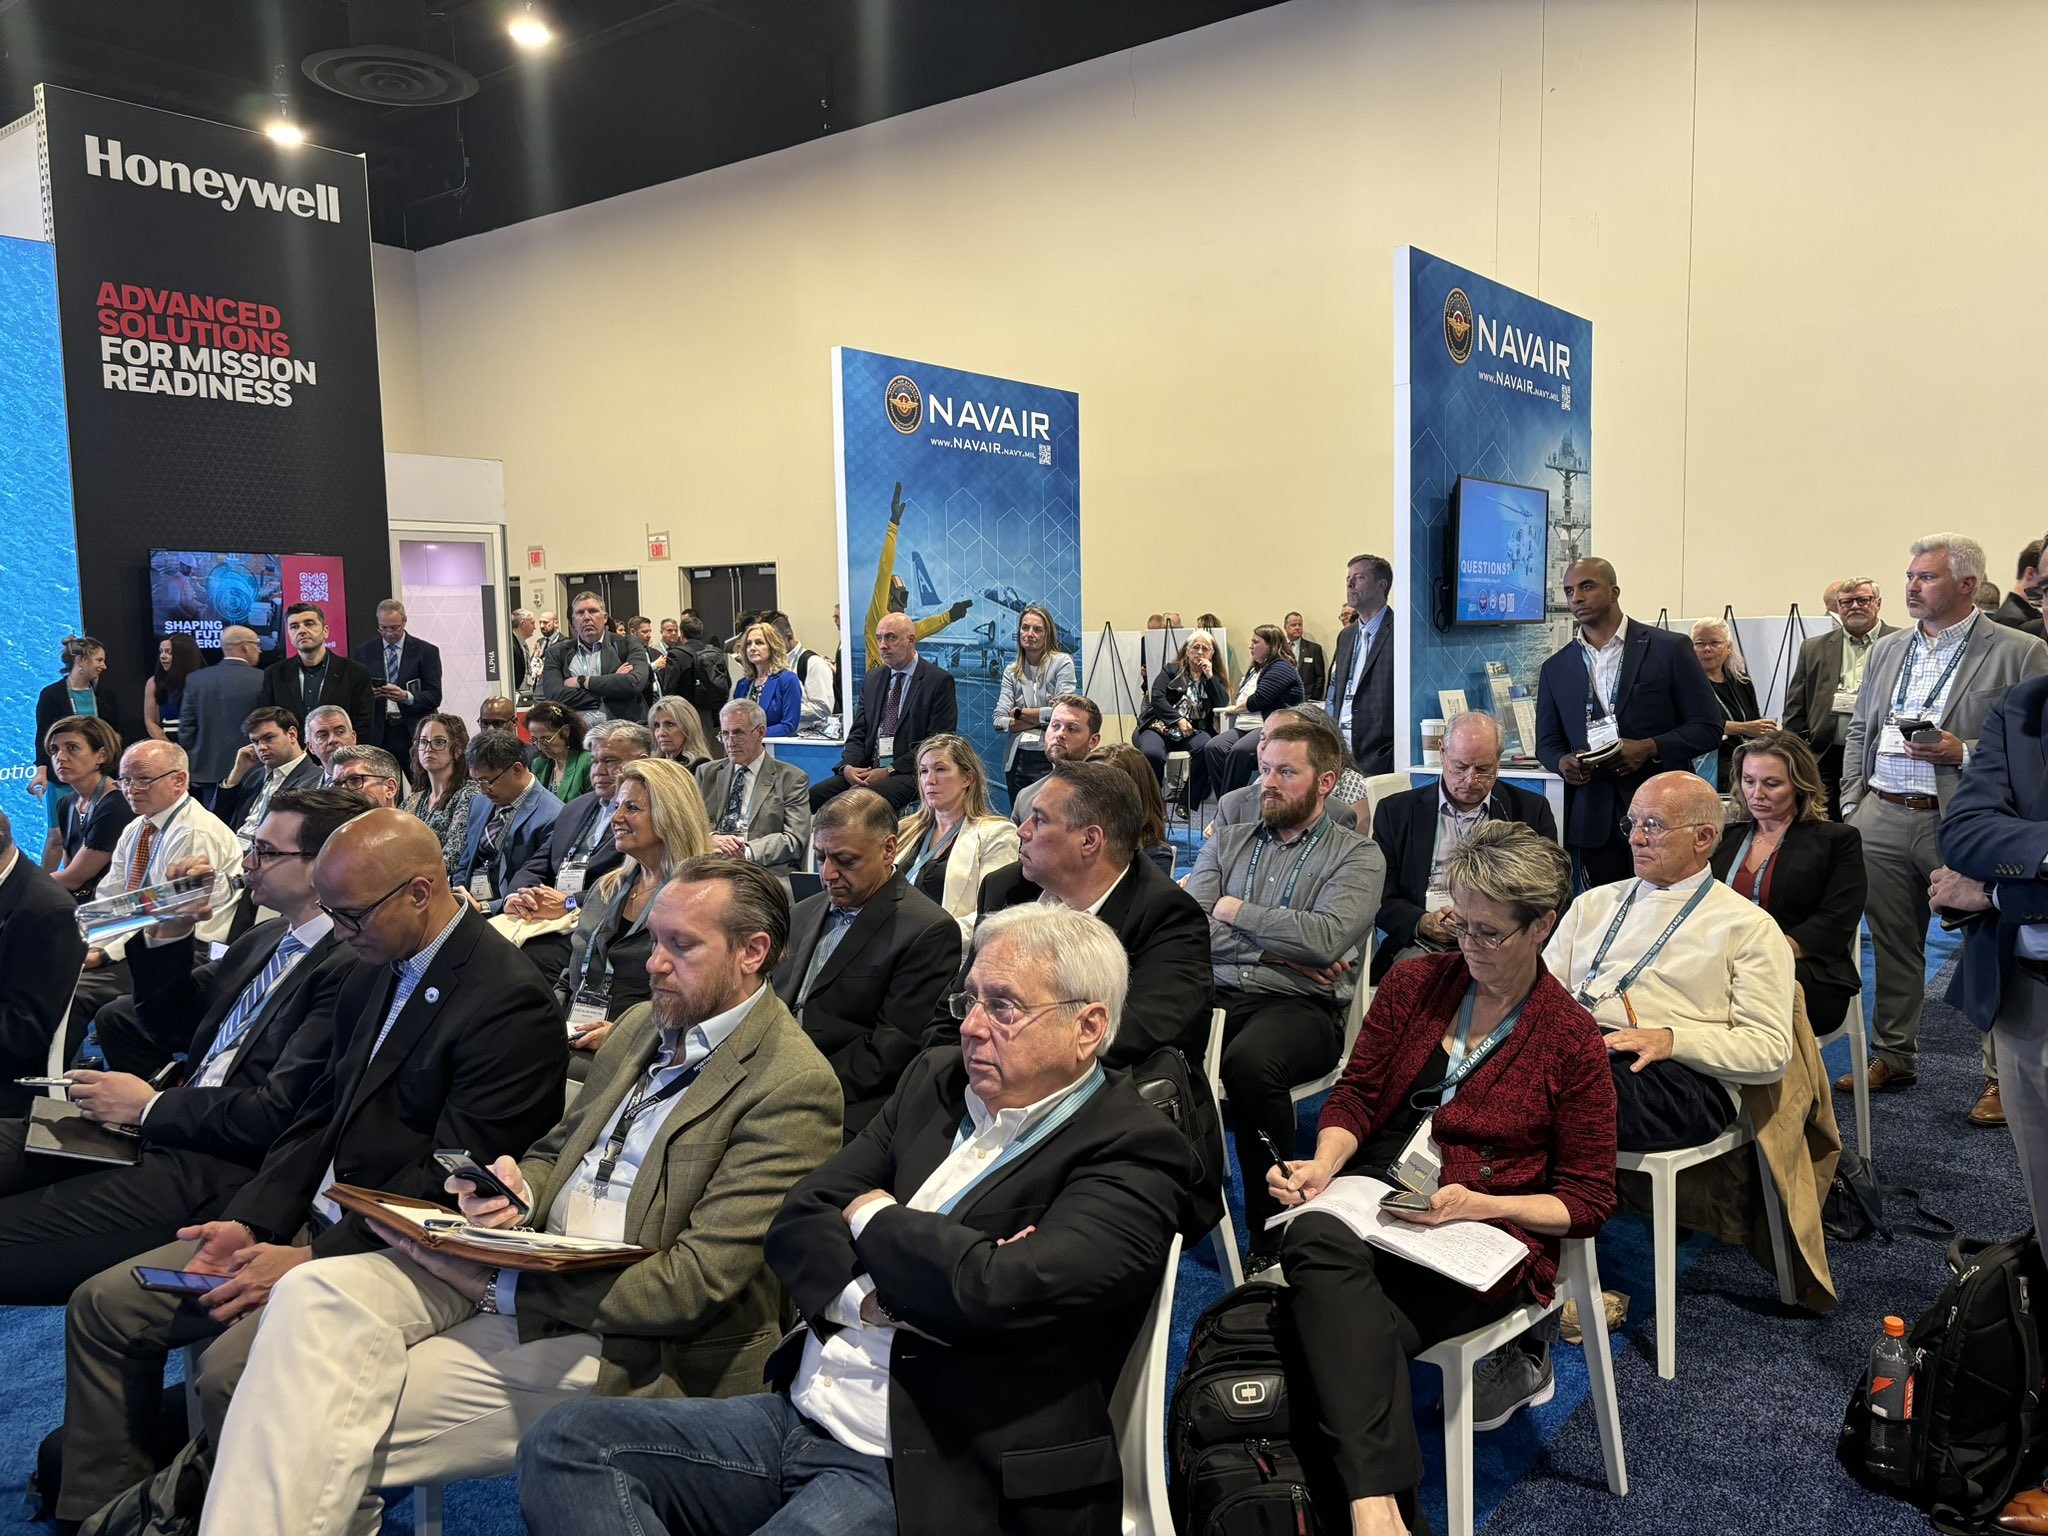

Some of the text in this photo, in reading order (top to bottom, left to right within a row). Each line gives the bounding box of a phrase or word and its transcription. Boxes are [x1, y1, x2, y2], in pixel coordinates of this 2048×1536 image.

[84, 134, 341, 224] Honeywell
[96, 281, 282, 330] ADVANCED
[98, 308, 291, 357] SOLUTIONS
[1478, 313, 1571, 381] NAVAIR
[100, 335, 317, 385] FOR MISSION
[102, 363, 293, 407] READINESS
[928, 393, 1050, 441] NAVAIR
[930, 437, 1037, 459] www.NAVAIR.NAVY.MIL
[1460, 559, 1511, 576] QUESTIONS?
[164, 620, 224, 631] SHAPING
[488, 650, 497, 674] ALPHA
[1300, 836, 1319, 861] ADVANTAGE
[1658, 915, 1684, 945] ADVANTAGE
[1456, 1037, 1495, 1078] ADVANTAGE
